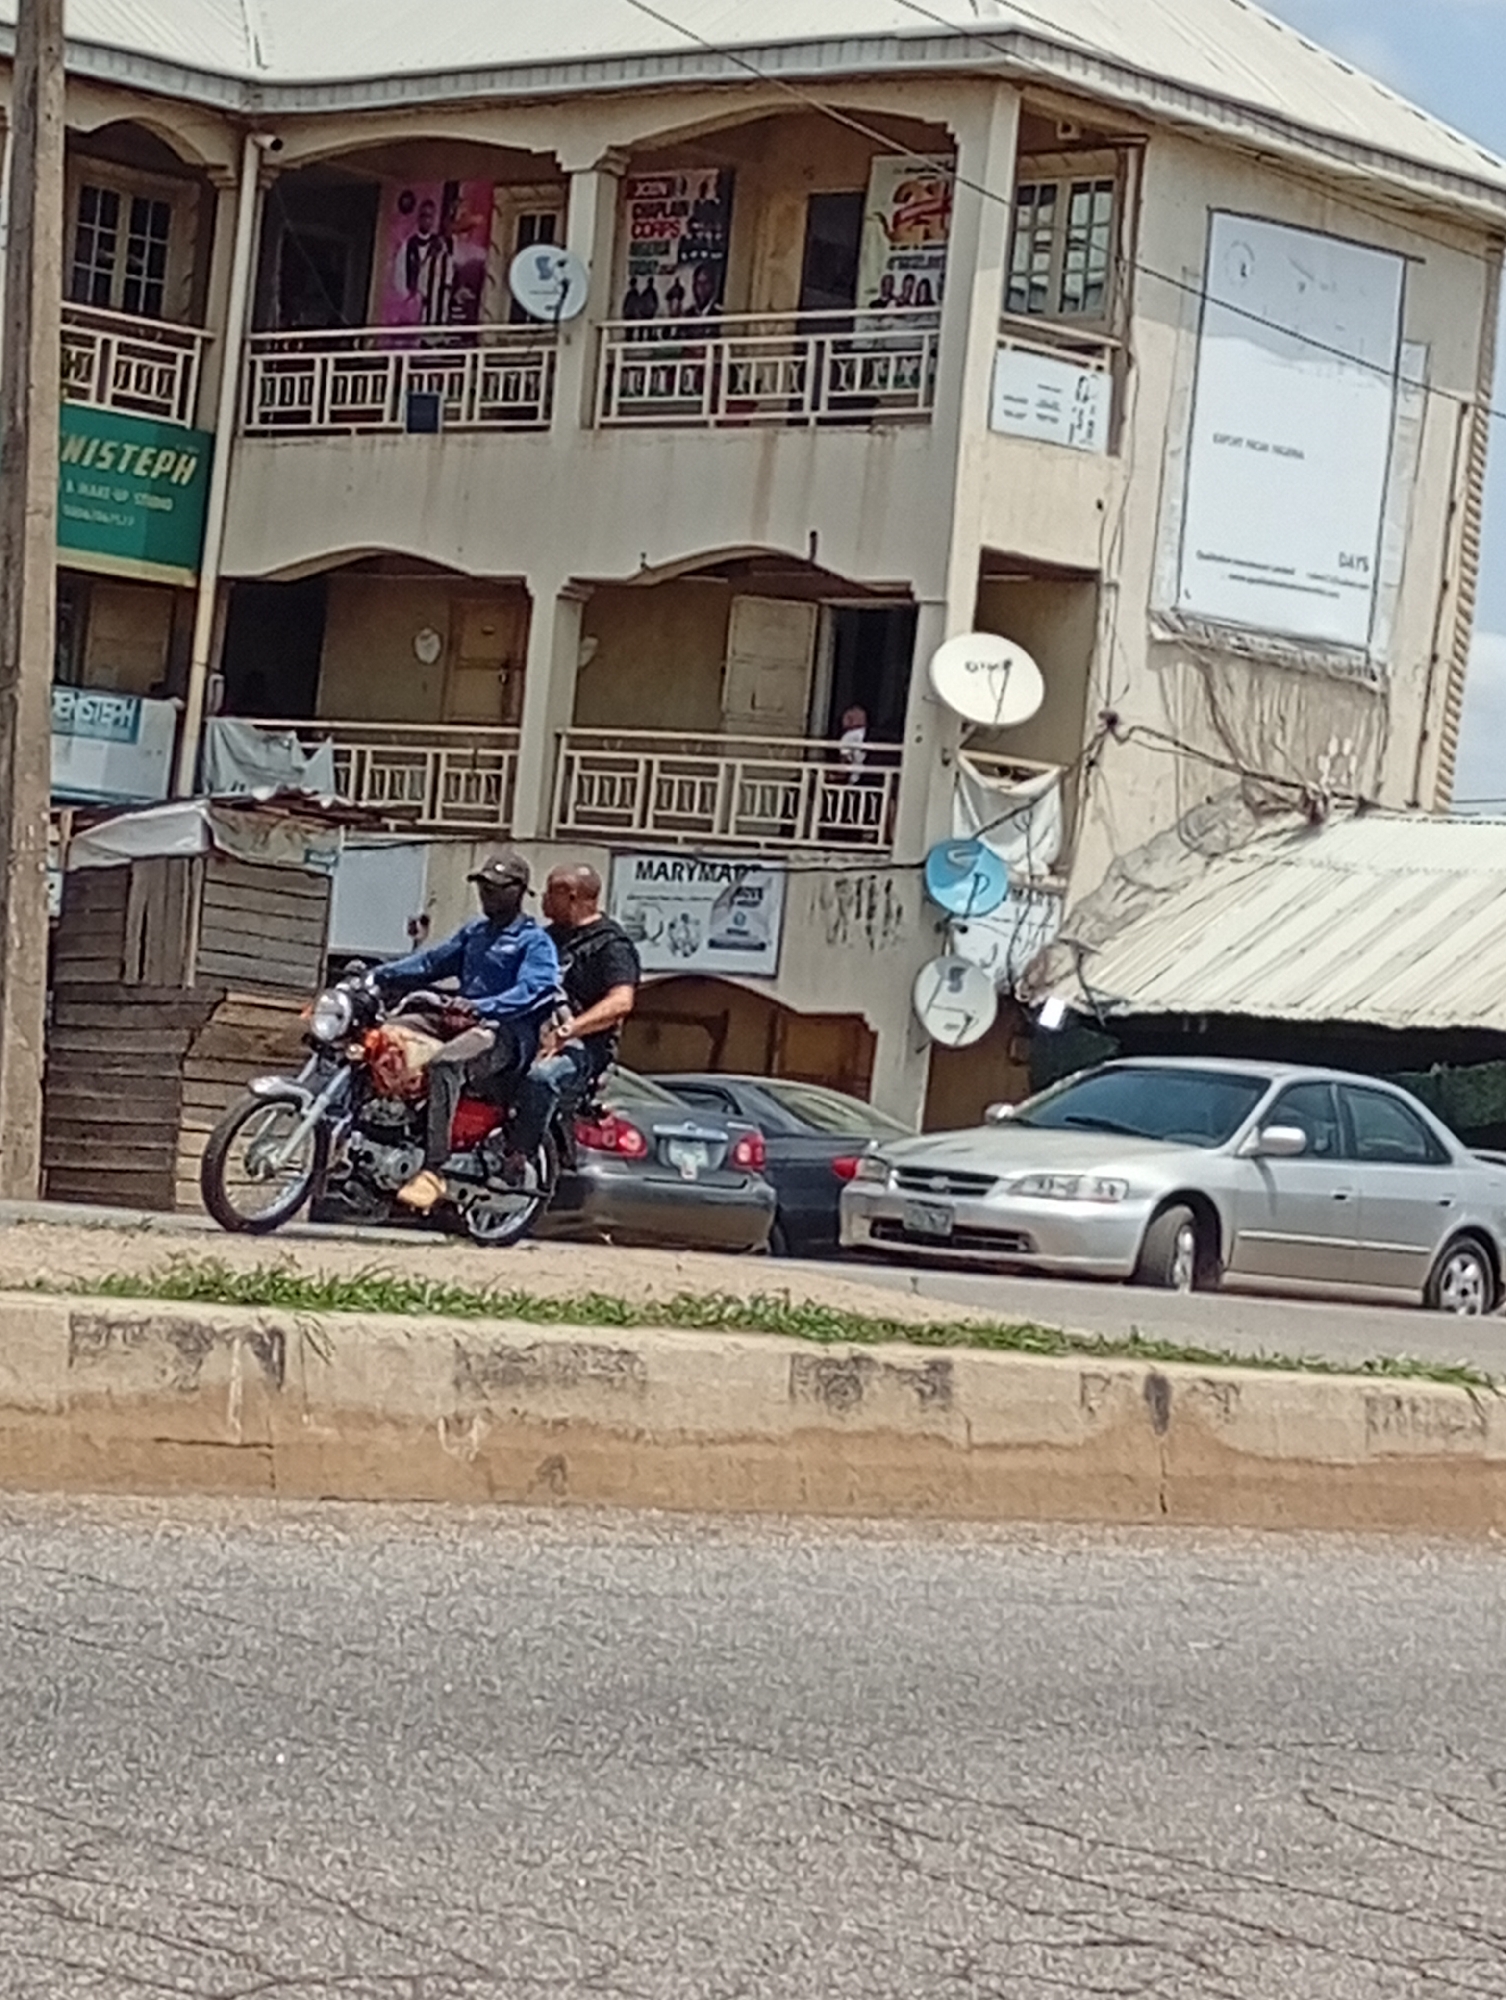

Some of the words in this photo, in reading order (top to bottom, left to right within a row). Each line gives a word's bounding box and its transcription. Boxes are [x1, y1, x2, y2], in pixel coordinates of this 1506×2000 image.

[631, 220, 681, 240] CORPS
[60, 432, 198, 486] NISTEPH
[1338, 551, 1370, 573] DAYS
